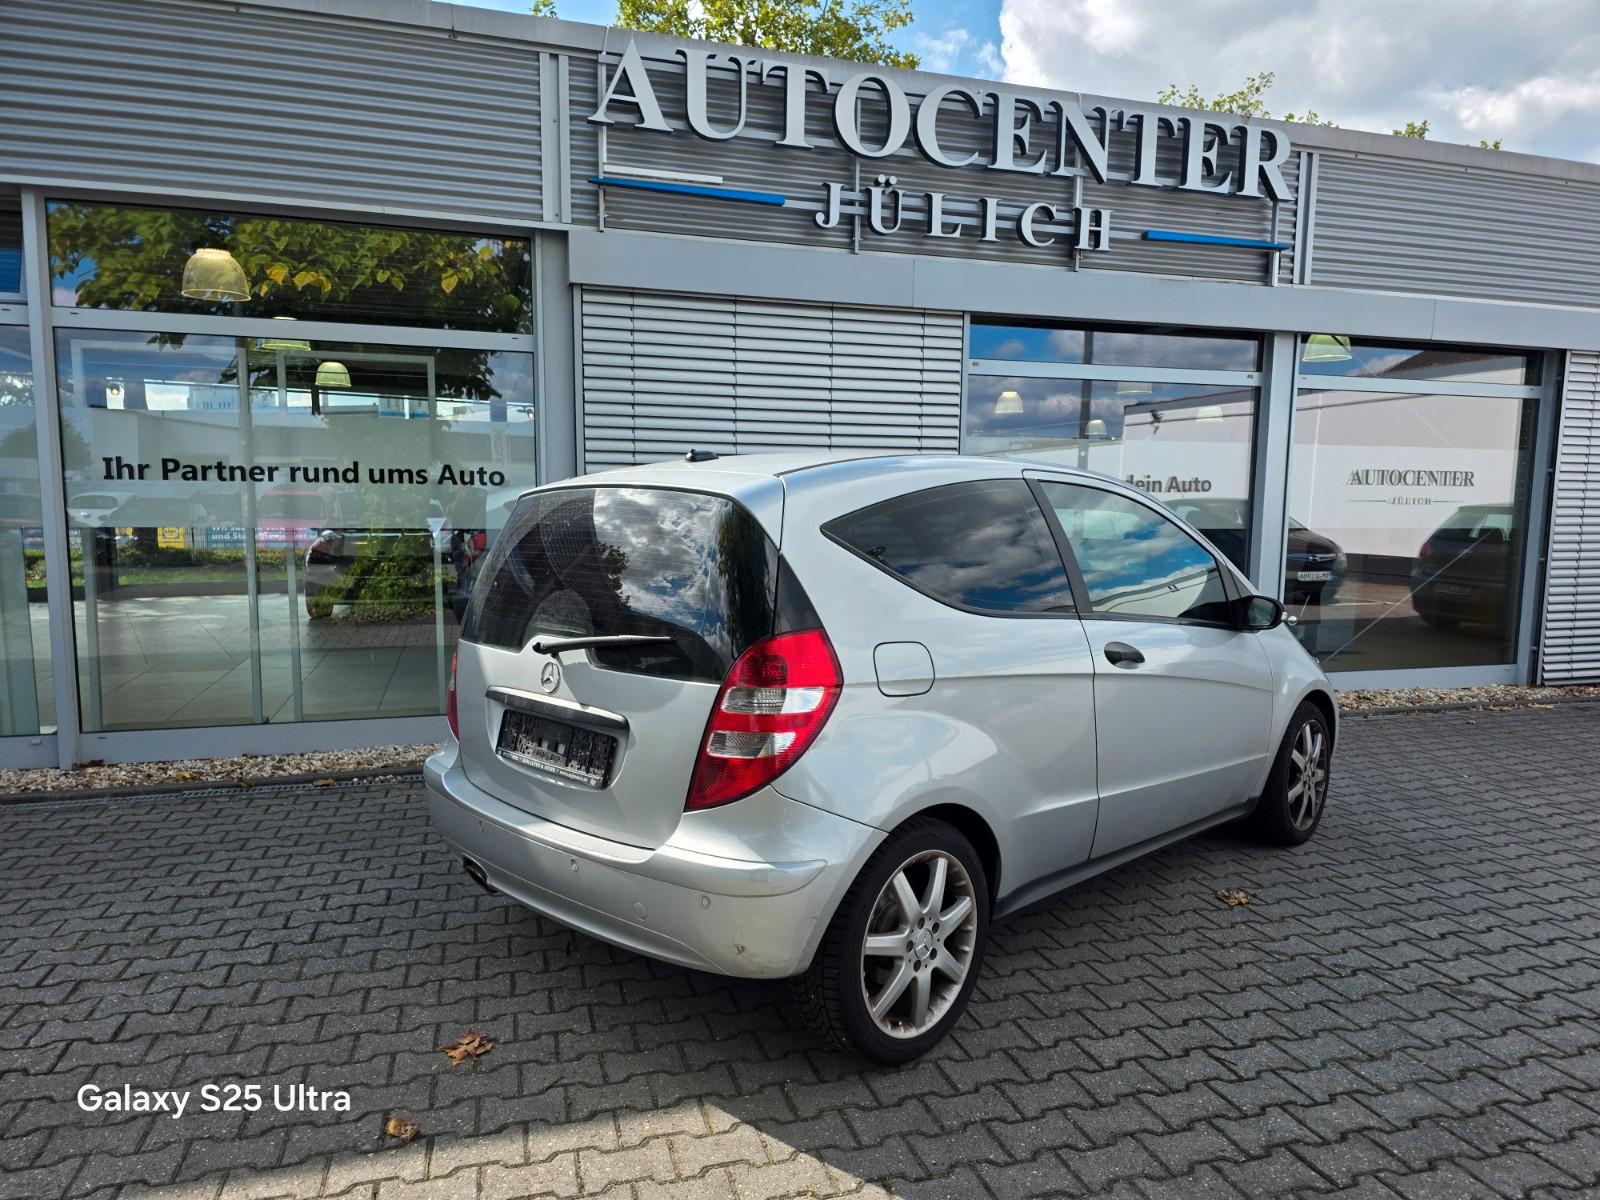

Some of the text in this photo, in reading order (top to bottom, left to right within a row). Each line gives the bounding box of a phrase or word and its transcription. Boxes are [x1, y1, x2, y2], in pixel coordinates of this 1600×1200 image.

[587, 38, 1294, 203] AUTOCENTER
[814, 173, 1113, 253] JÜLICH
[102, 456, 506, 487] Ihr Partner rund ums Auto
[1166, 476, 1213, 493] Auto
[1348, 469, 1476, 487] AUTOCENTER
